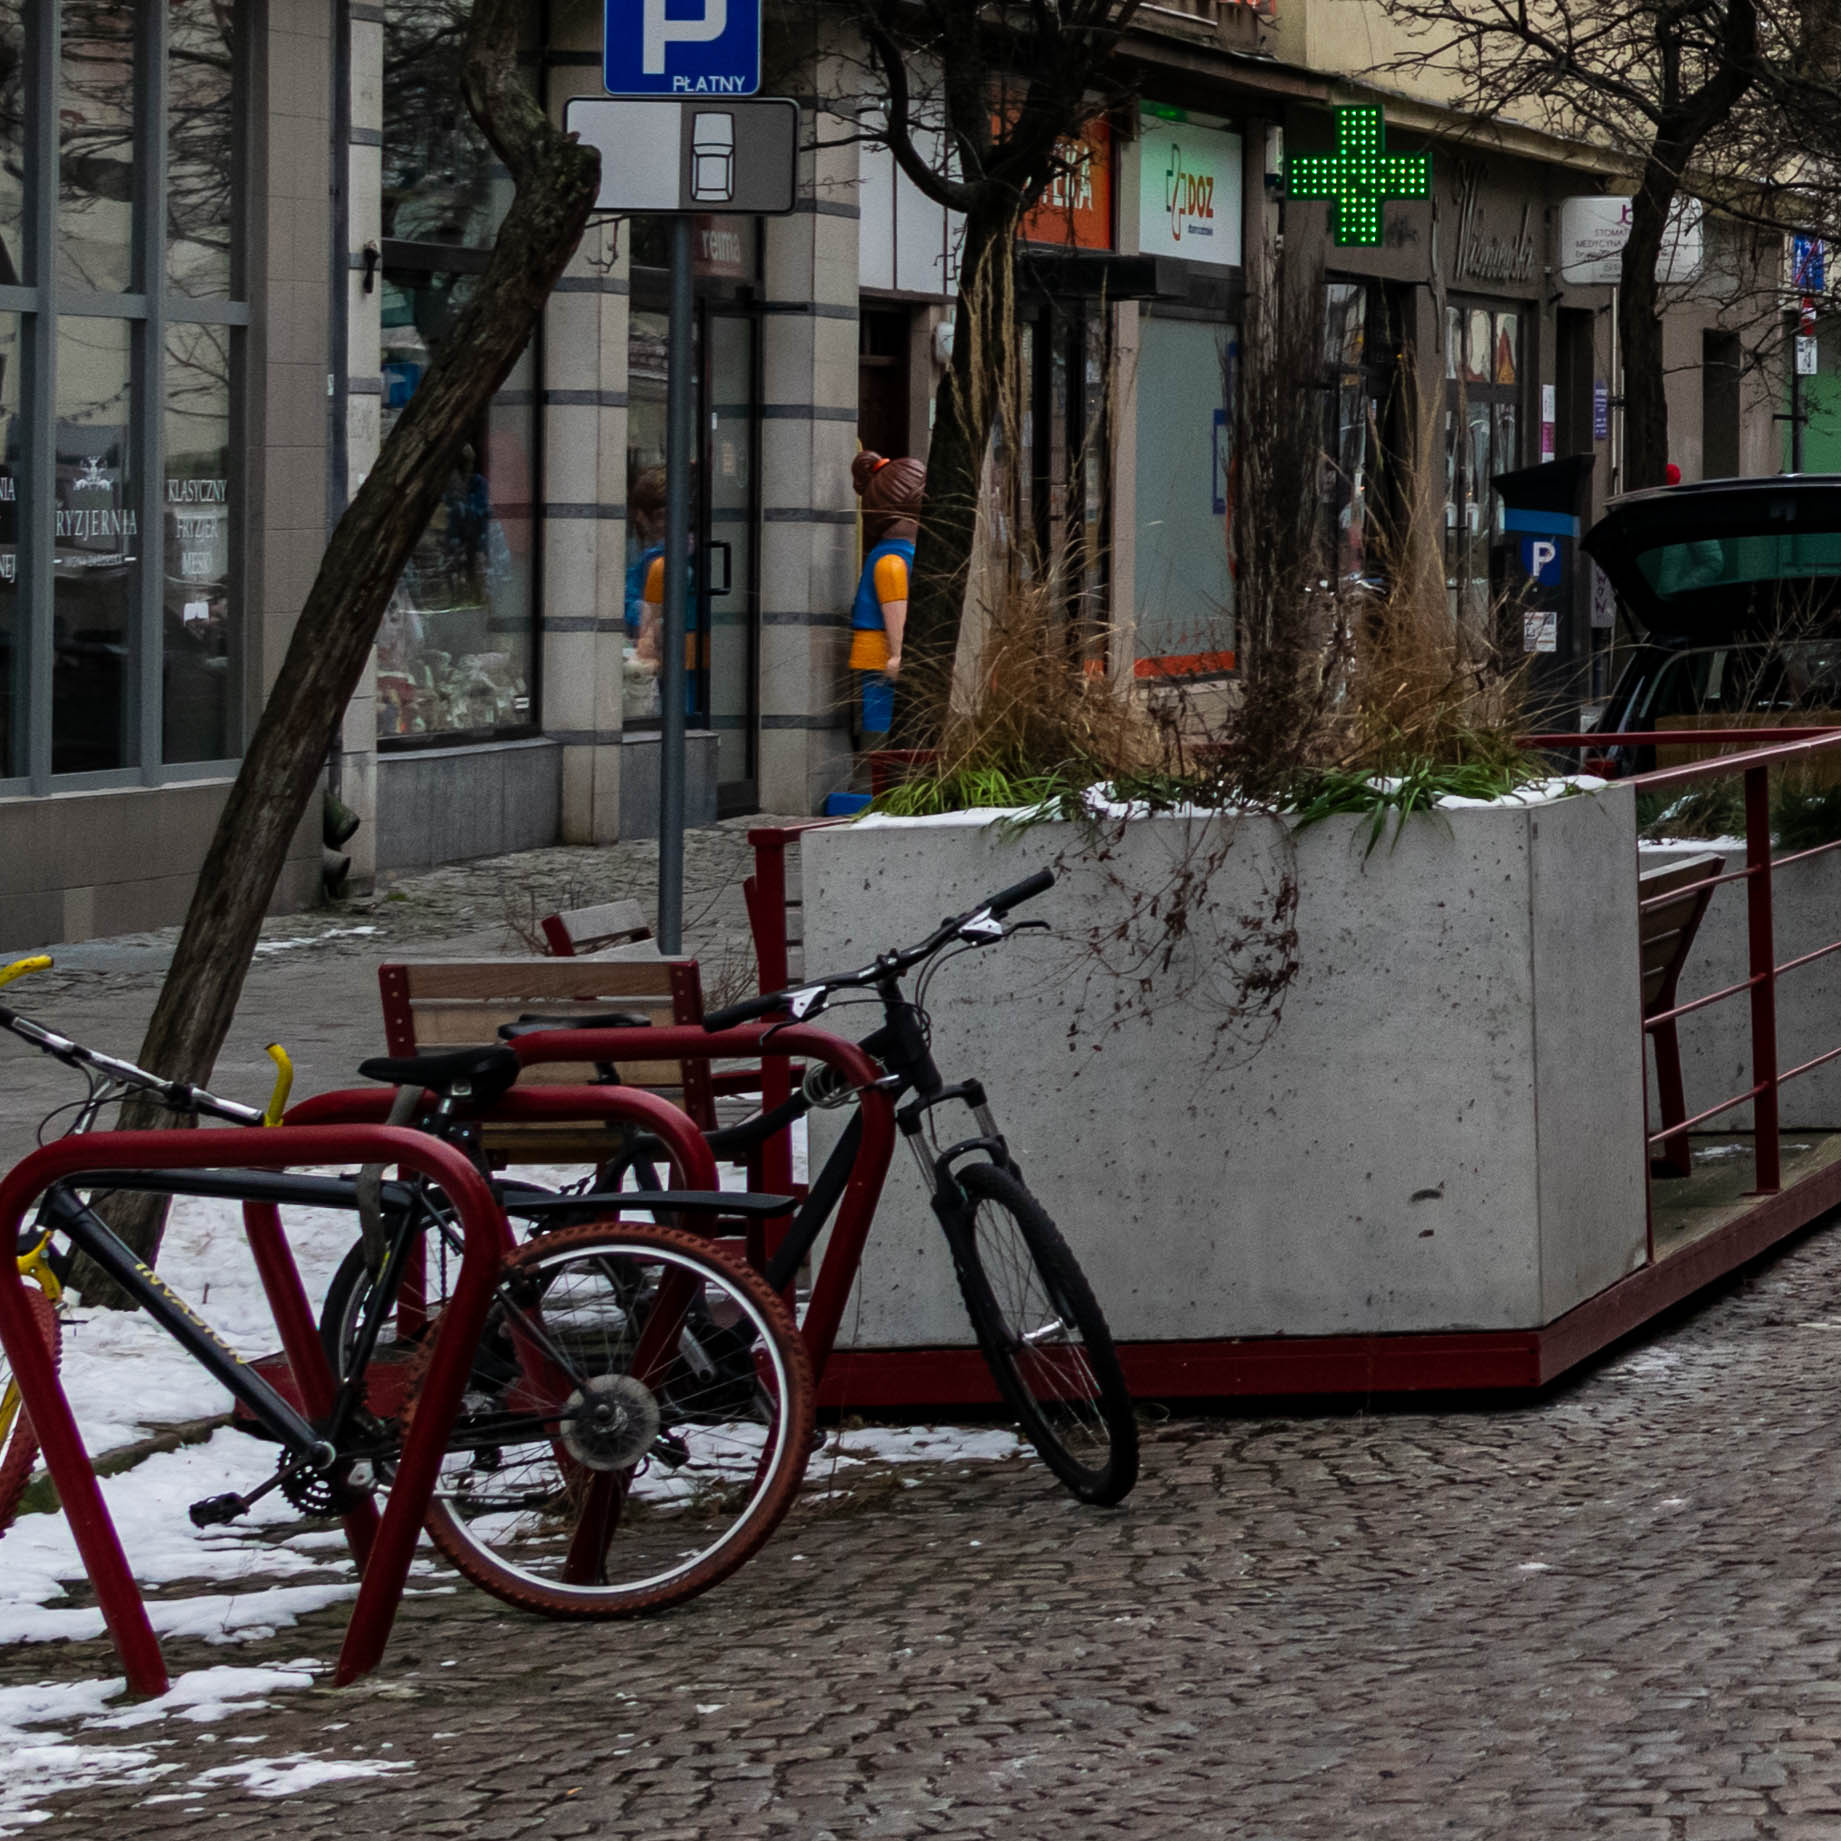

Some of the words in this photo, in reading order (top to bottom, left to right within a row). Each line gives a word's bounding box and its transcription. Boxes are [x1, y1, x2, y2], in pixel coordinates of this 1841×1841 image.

[672, 74, 746, 92] PŁATNY
[1187, 173, 1214, 219] DOZ
[702, 231, 741, 263] reima
[167, 479, 228, 502] KLASYCZNY
[55, 509, 138, 542] RYZJERNIA
[1532, 541, 1556, 577] P
